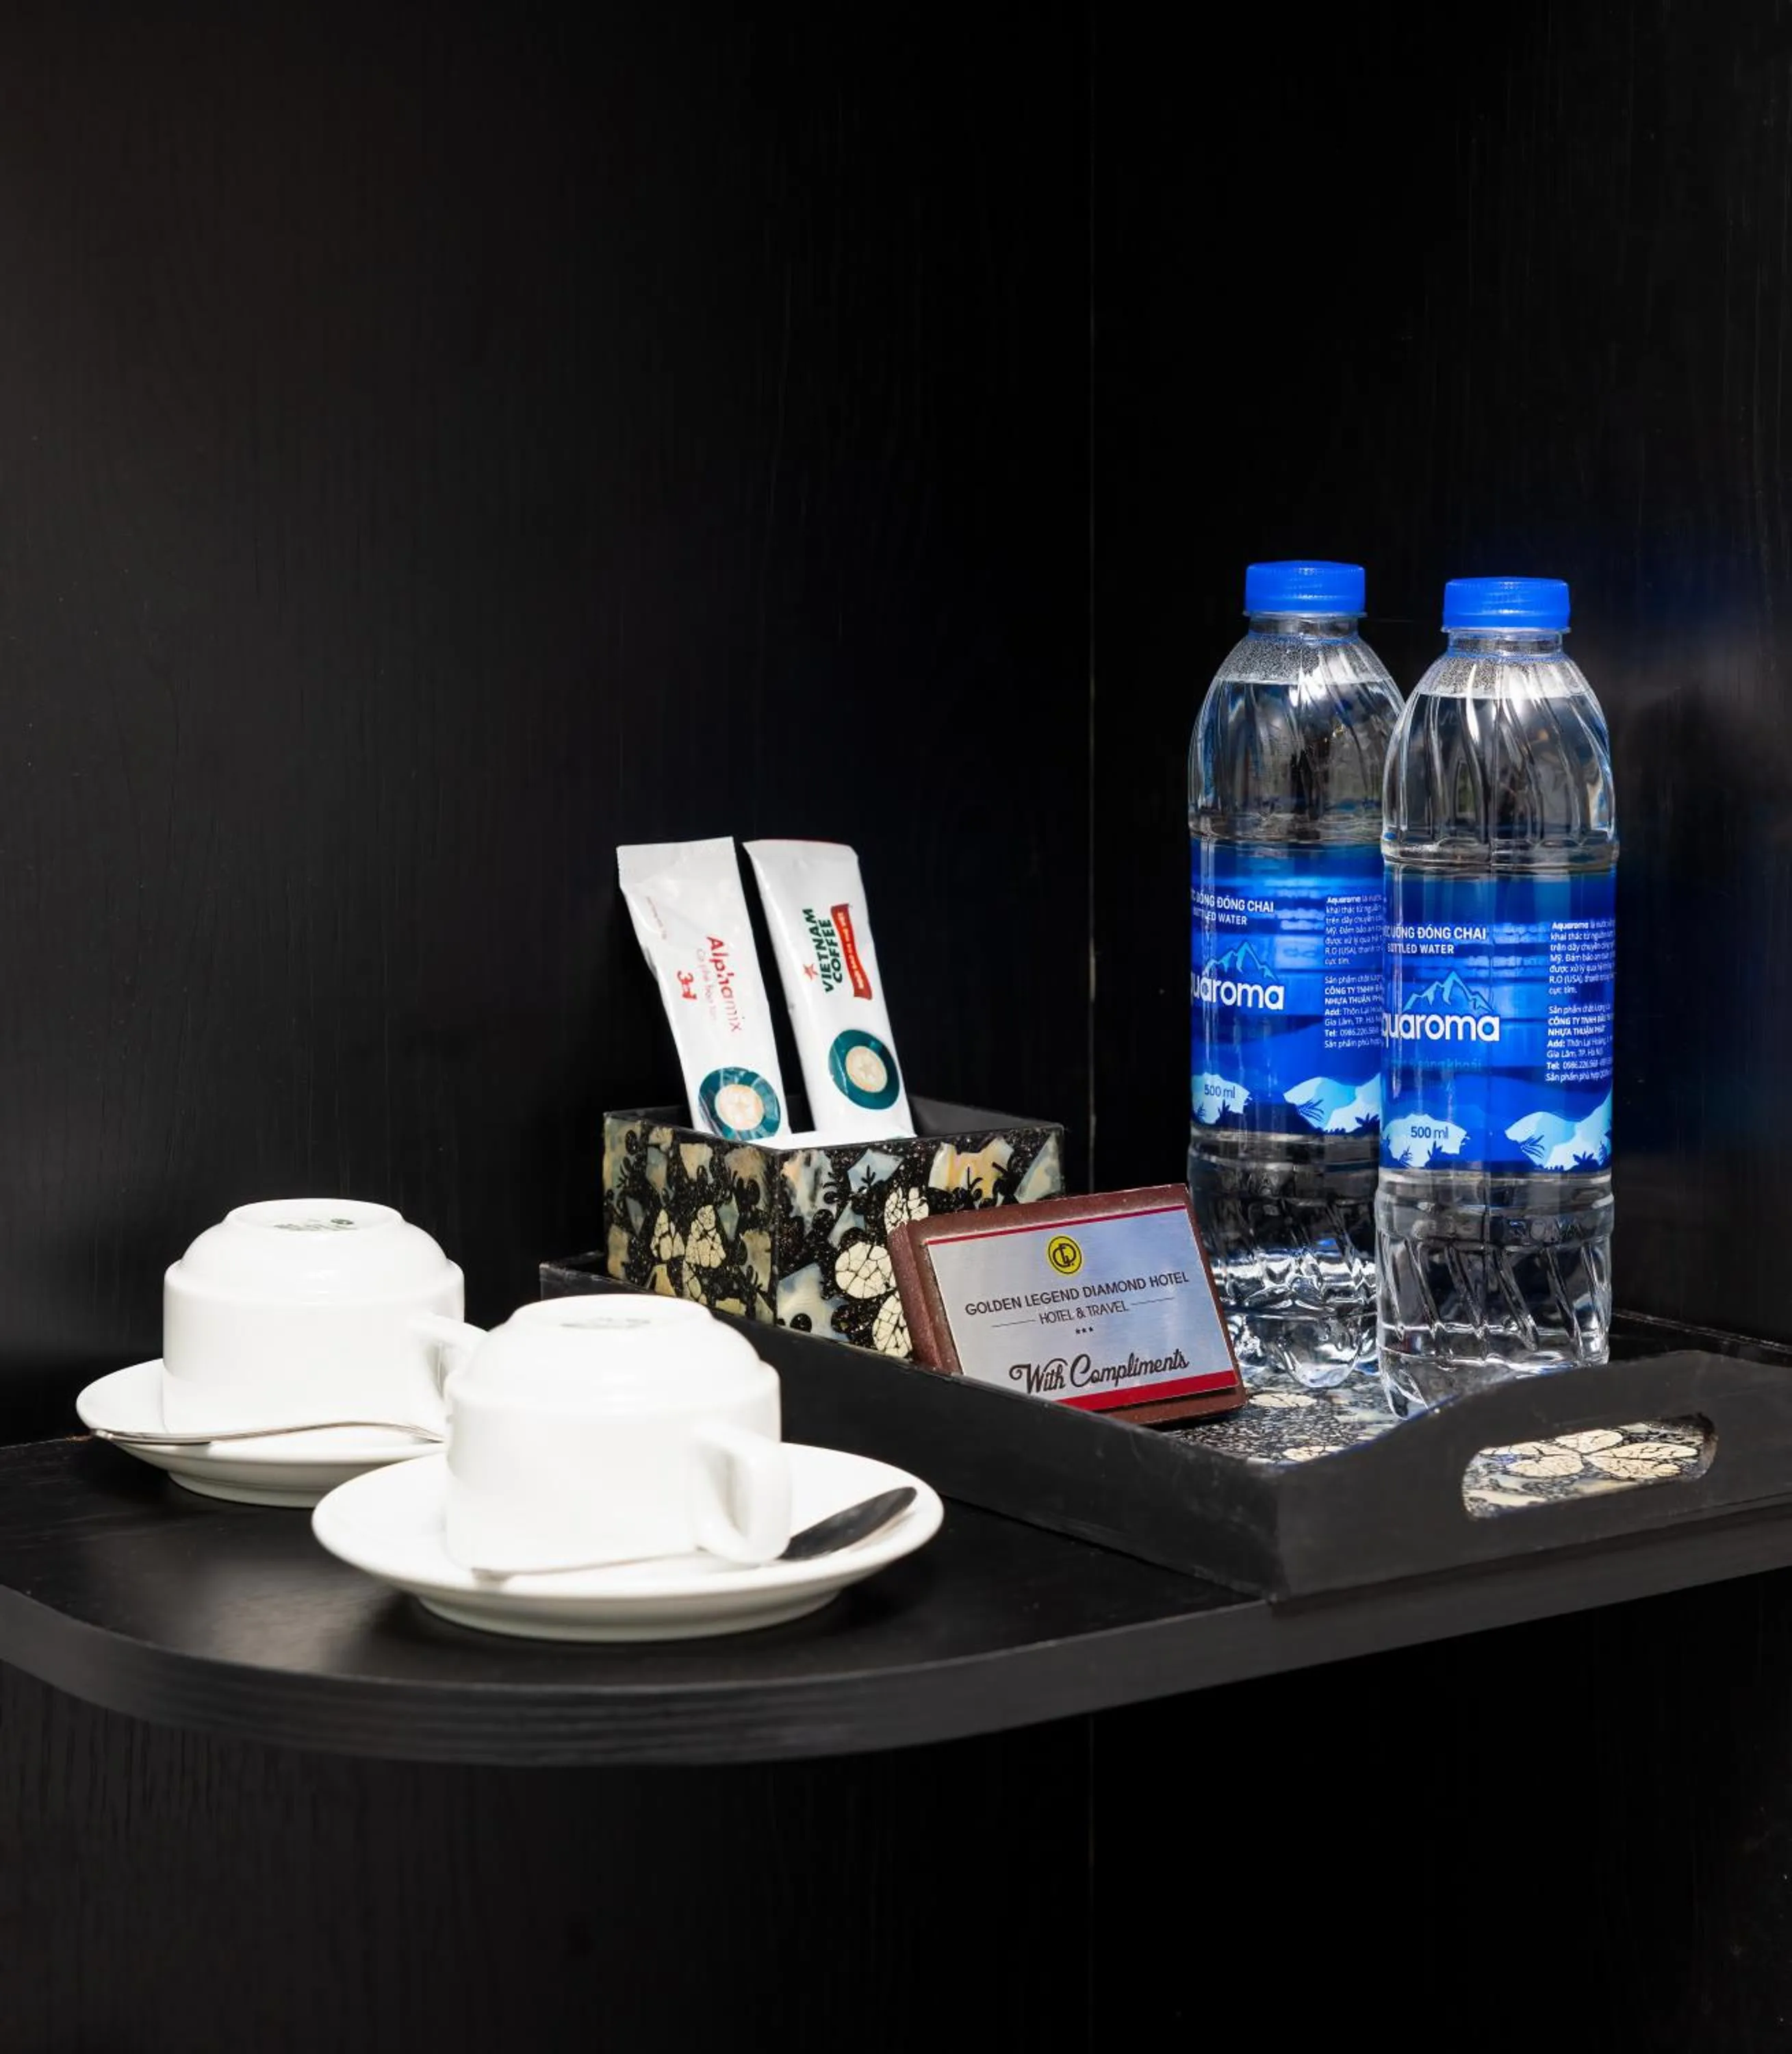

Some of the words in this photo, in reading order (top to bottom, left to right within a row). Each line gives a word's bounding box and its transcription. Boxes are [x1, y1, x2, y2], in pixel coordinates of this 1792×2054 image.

[1247, 900, 1274, 913] CHAI
[1218, 913, 1247, 925] WATER
[1454, 926, 1486, 940] CHAI
[802, 908, 834, 993] VIETNAM
[819, 920, 843, 983] COFFEE
[1420, 943, 1454, 954] WATER
[706, 936, 742, 1032] Alphamix
[1324, 985, 1346, 995] CÔNG
[1347, 986, 1355, 994] TY
[1548, 1015, 1571, 1026] CÔNG
[1548, 1028, 1572, 1037] NHỰA
[1205, 1085, 1221, 1097] 500
[1223, 1086, 1236, 1098] ml
[1411, 1126, 1431, 1138] 500
[1434, 1126, 1448, 1139] ml
[965, 1297, 1022, 1315] GOLDEN
[1025, 1288, 1079, 1306] LEGEND
[1082, 1278, 1147, 1297] DIAMOND
[1149, 1271, 1190, 1287] HOTEL
[1039, 1308, 1073, 1324] HOTEL
[1076, 1306, 1086, 1319] &
[1086, 1300, 1129, 1317] TRAVEL
[1009, 1358, 1068, 1394] With
[1069, 1348, 1190, 1388] Compliments
